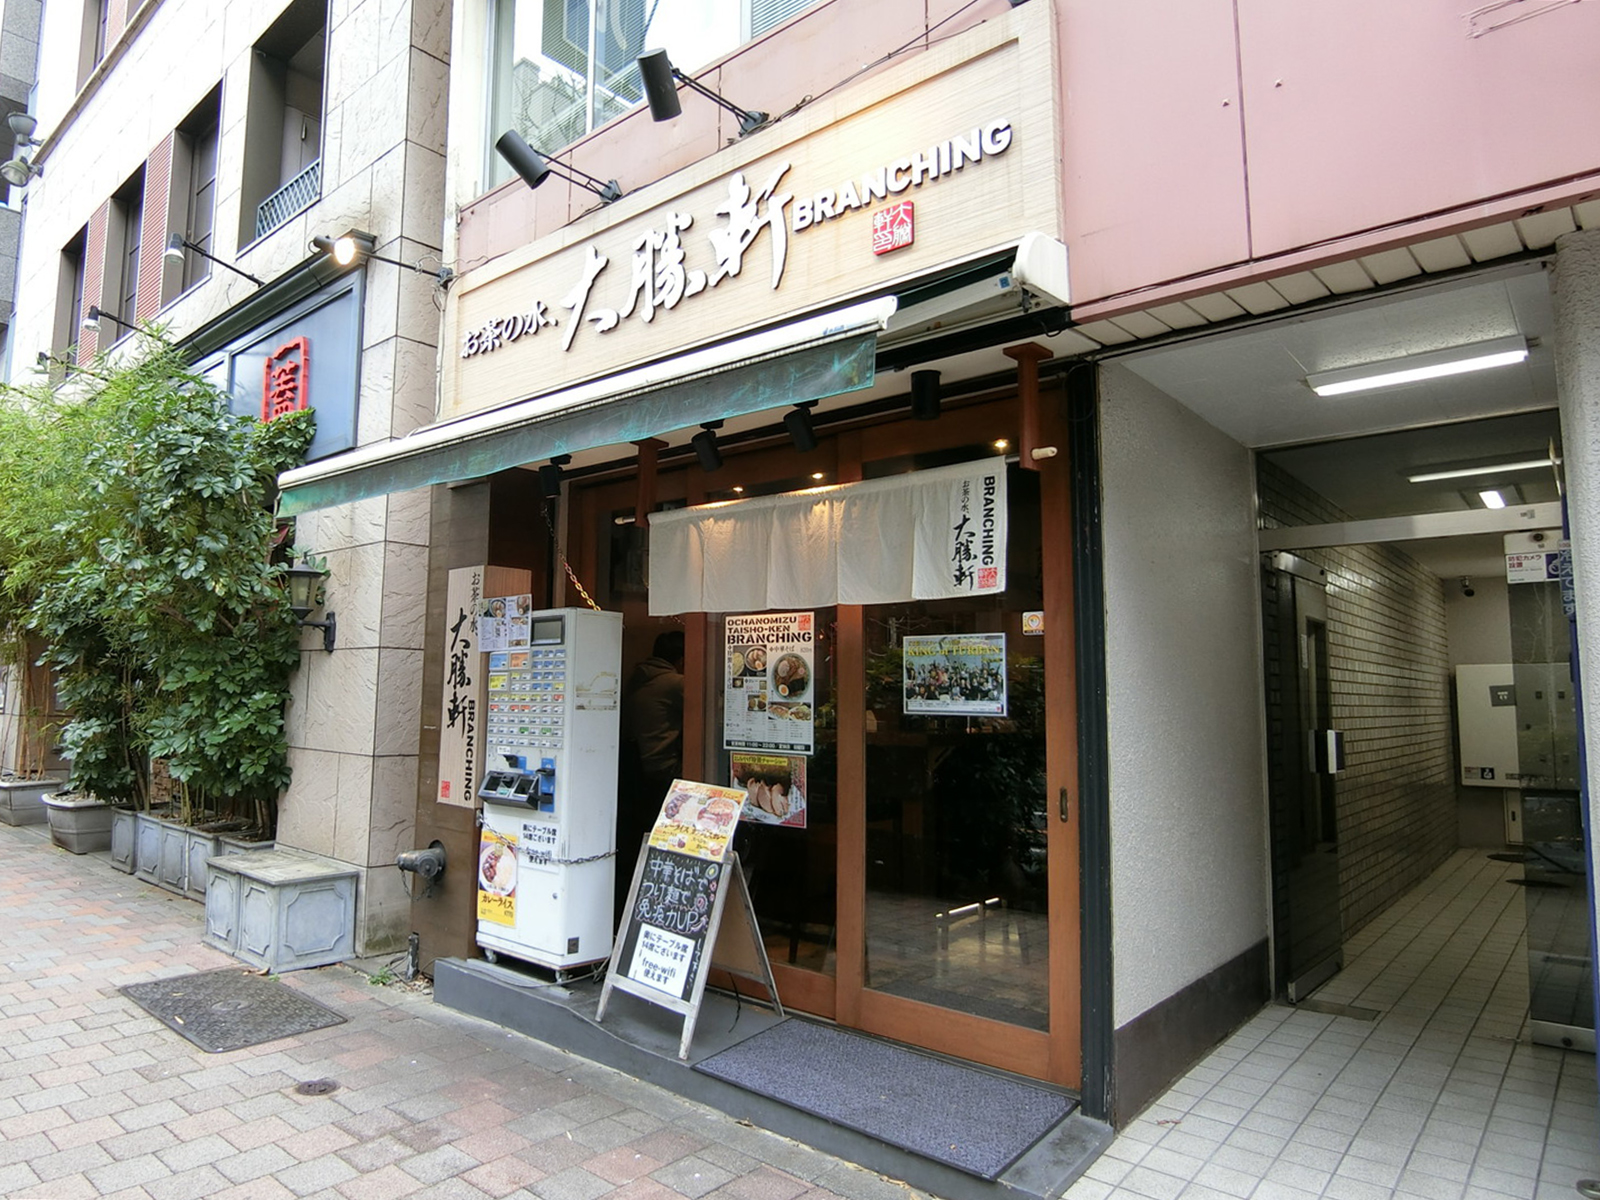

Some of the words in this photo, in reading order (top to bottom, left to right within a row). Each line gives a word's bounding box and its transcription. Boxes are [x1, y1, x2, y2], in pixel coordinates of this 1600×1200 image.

[792, 118, 1013, 233] BRANCHING
[981, 475, 996, 567] BRANCHING
[727, 616, 797, 627] OCHANOMIZU
[727, 625, 791, 635] TAISHO-KEN
[727, 632, 812, 645] BRANCHING
[463, 700, 476, 802] BRANCHING
[641, 957, 676, 978] free-wifi
